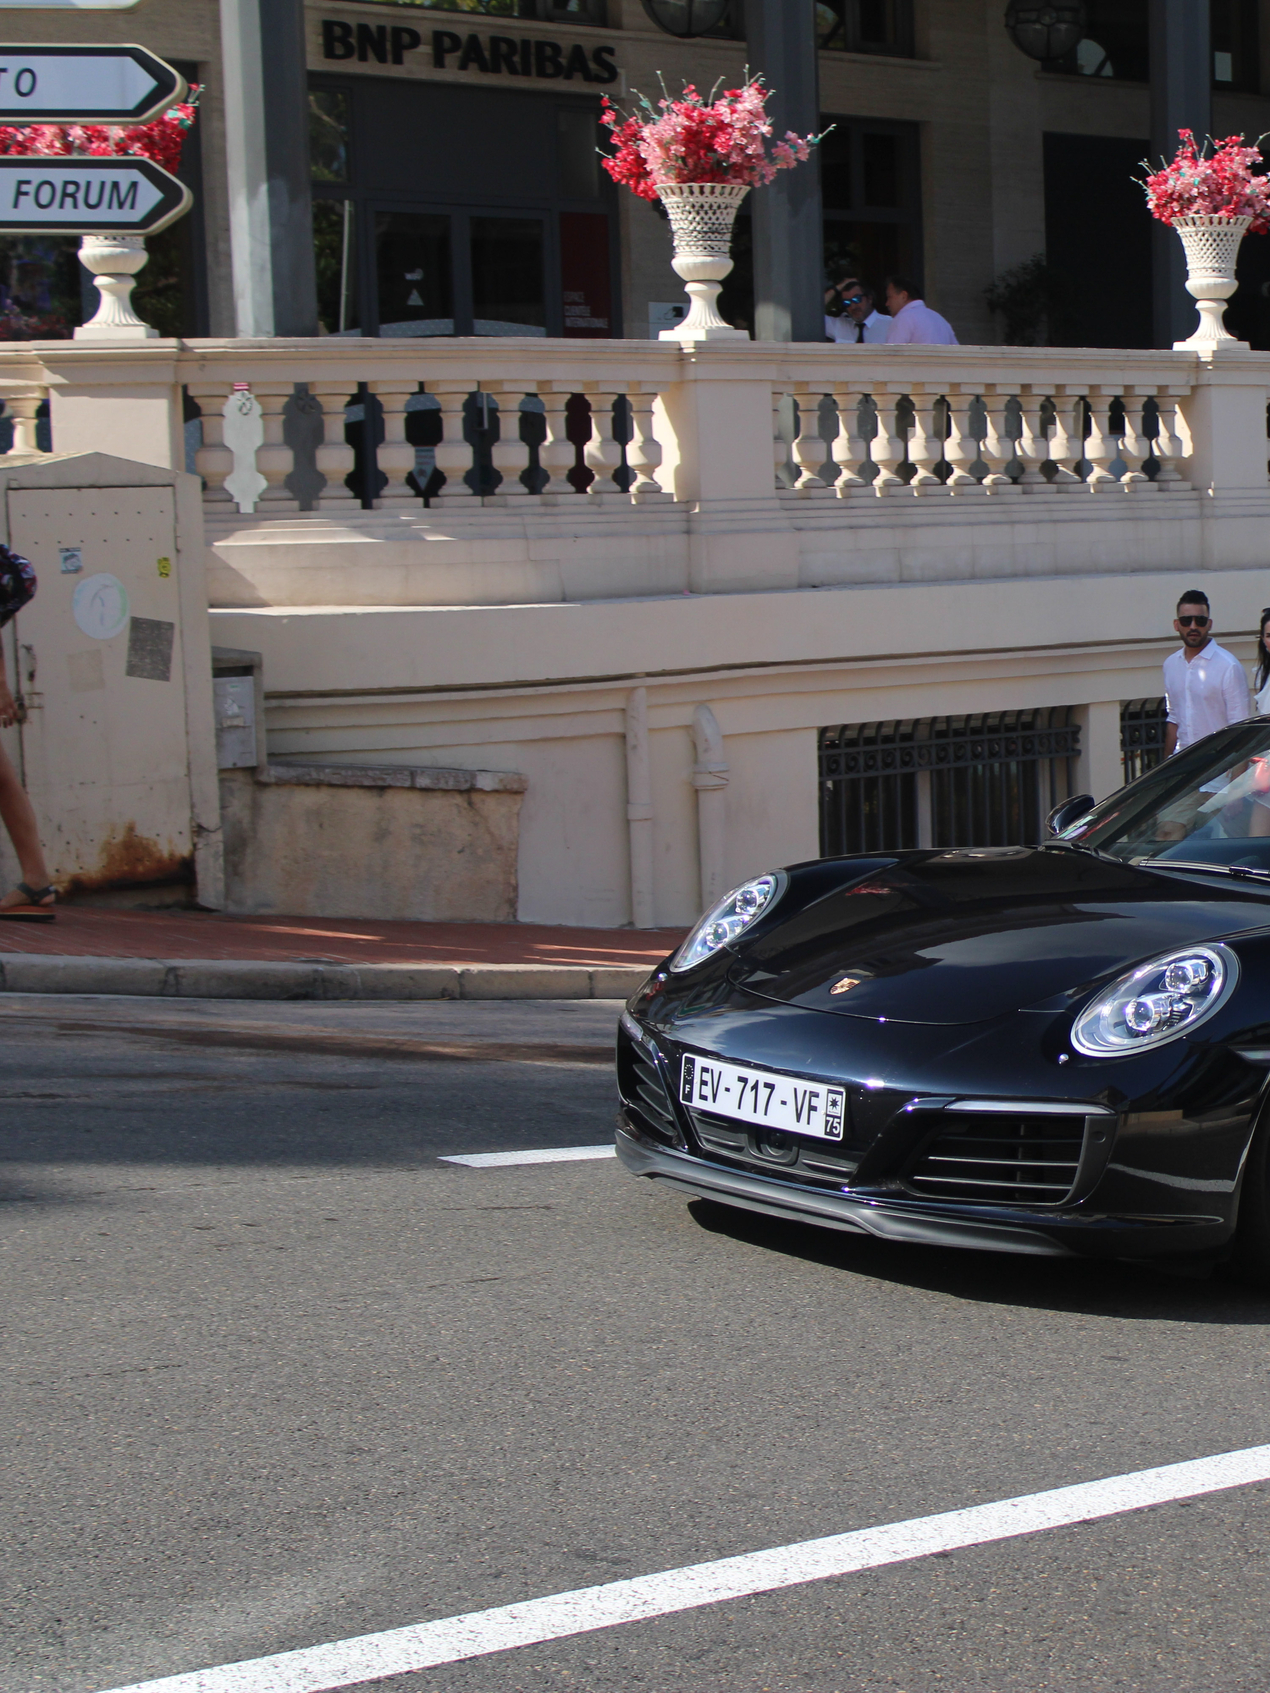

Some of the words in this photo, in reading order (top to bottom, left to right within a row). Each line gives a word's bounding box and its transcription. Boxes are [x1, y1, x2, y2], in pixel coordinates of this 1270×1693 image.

[322, 19, 422, 65] BNP
[432, 29, 619, 84] PARIBAS
[12, 179, 139, 210] FORUM
[685, 1084, 691, 1094] F
[826, 1116, 841, 1134] 75
